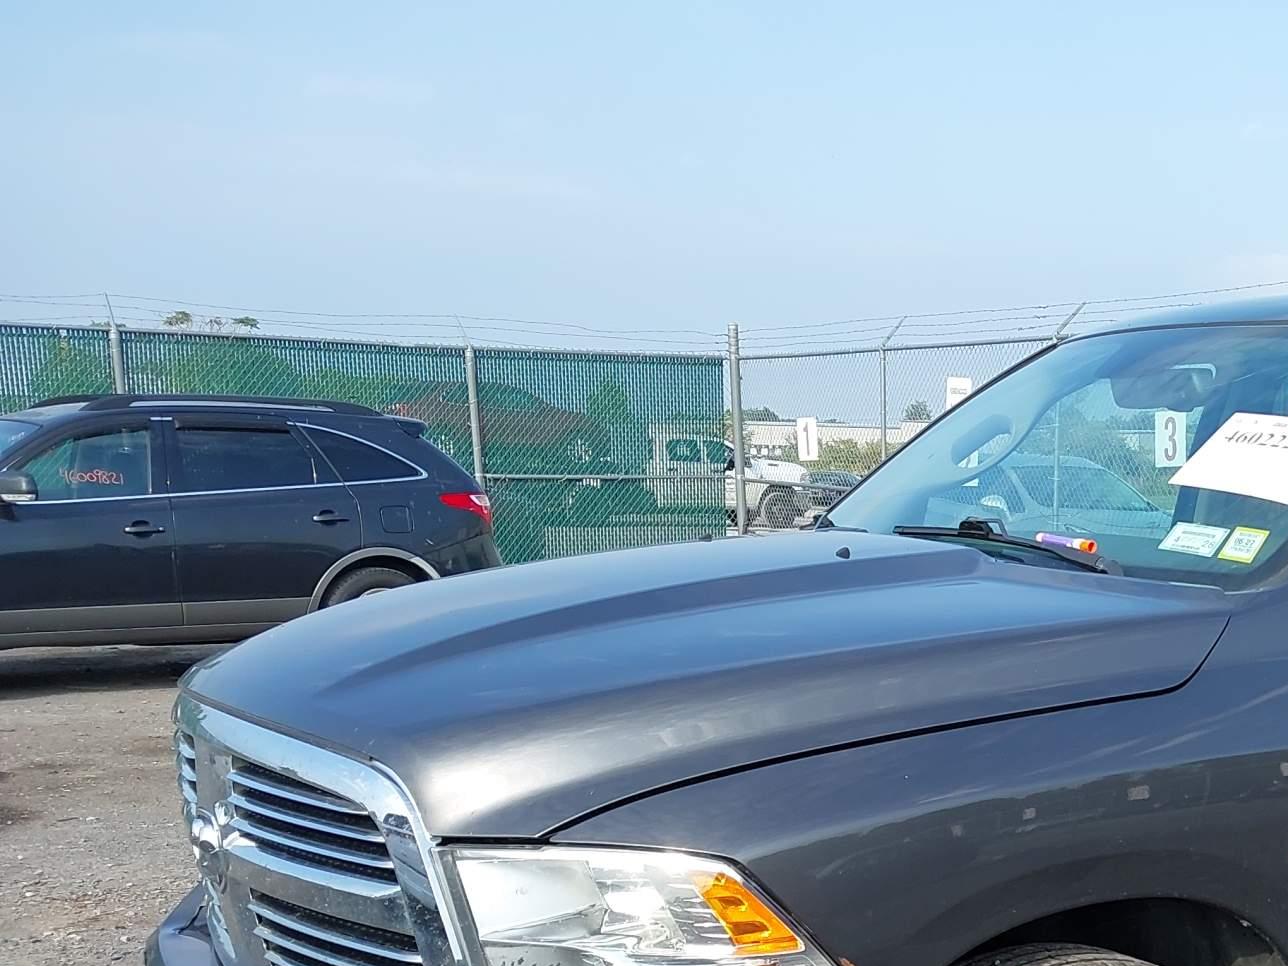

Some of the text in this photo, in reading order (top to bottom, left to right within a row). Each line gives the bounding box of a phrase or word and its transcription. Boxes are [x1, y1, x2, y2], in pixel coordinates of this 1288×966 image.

[803, 422, 810, 456] 1
[1164, 416, 1177, 462] 3
[58, 467, 125, 485] 46009821
